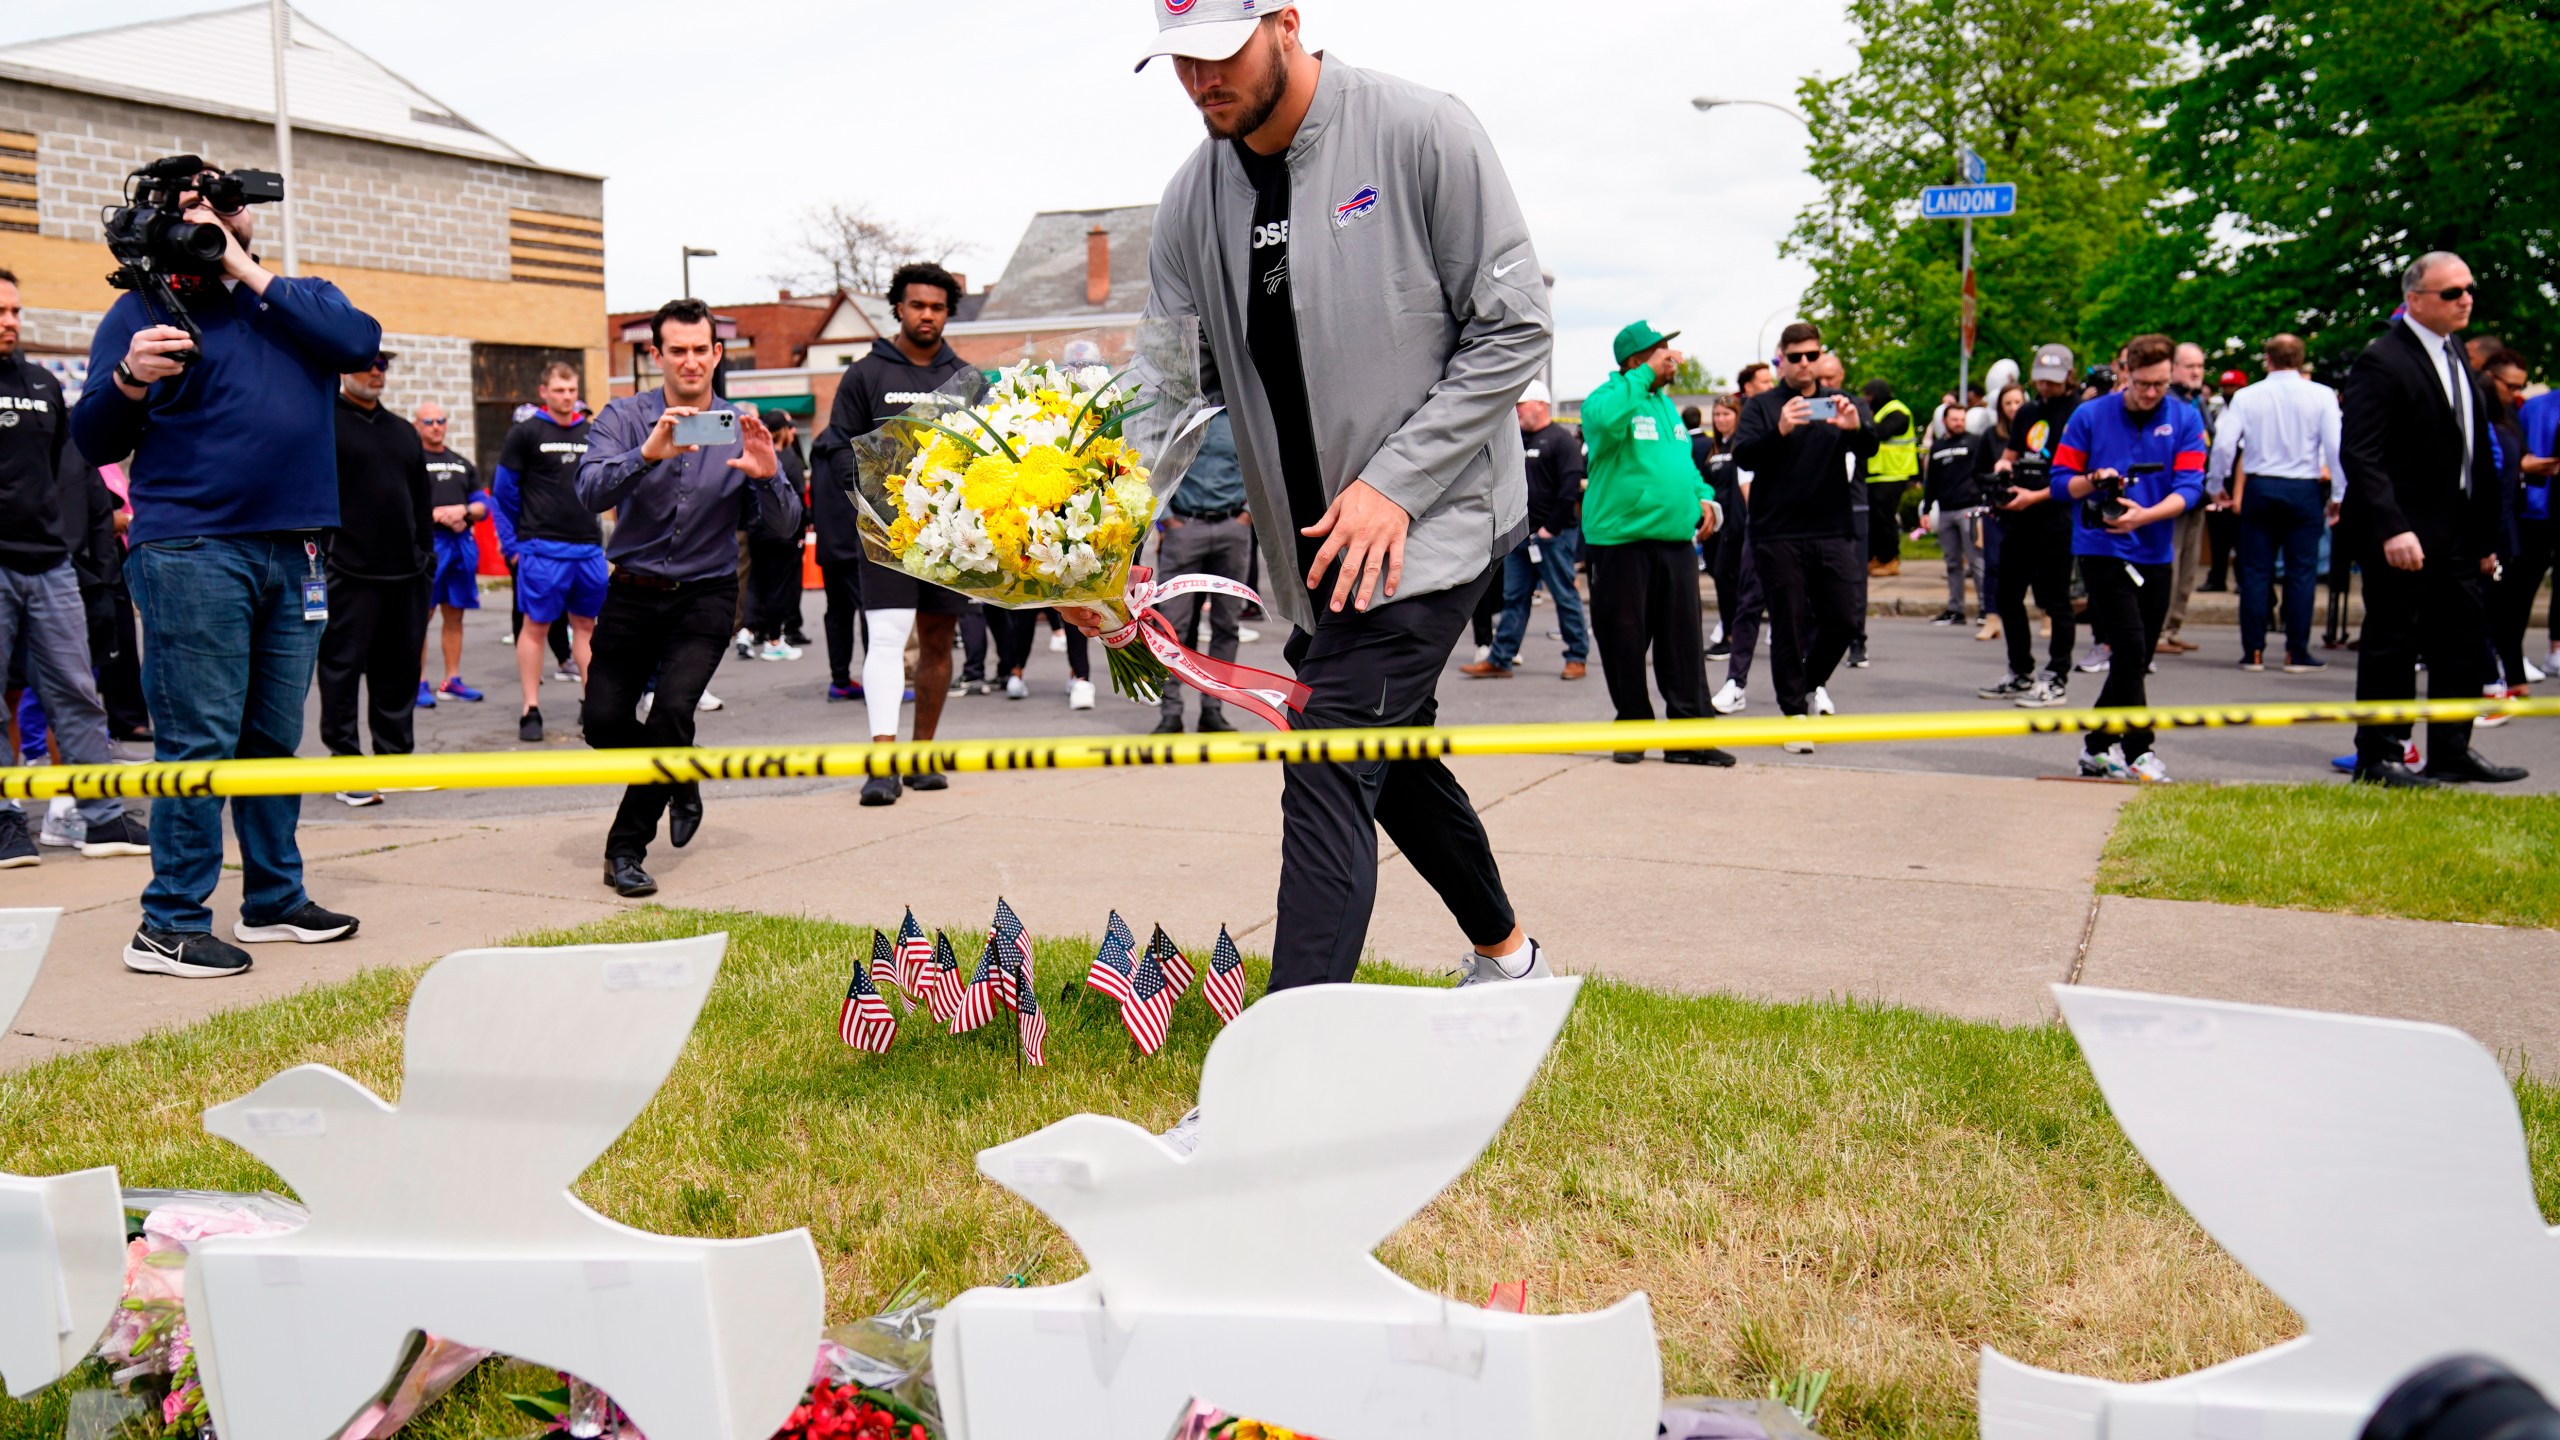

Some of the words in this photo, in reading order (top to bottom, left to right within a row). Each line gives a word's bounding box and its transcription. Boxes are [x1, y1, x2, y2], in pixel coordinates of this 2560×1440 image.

[1925, 189, 1996, 213] LANDON
[1253, 220, 1289, 249] OSE
[14, 397, 48, 413] LOVE
[884, 392, 935, 404] CHOOSE
[1172, 579, 1207, 591] BILLS
